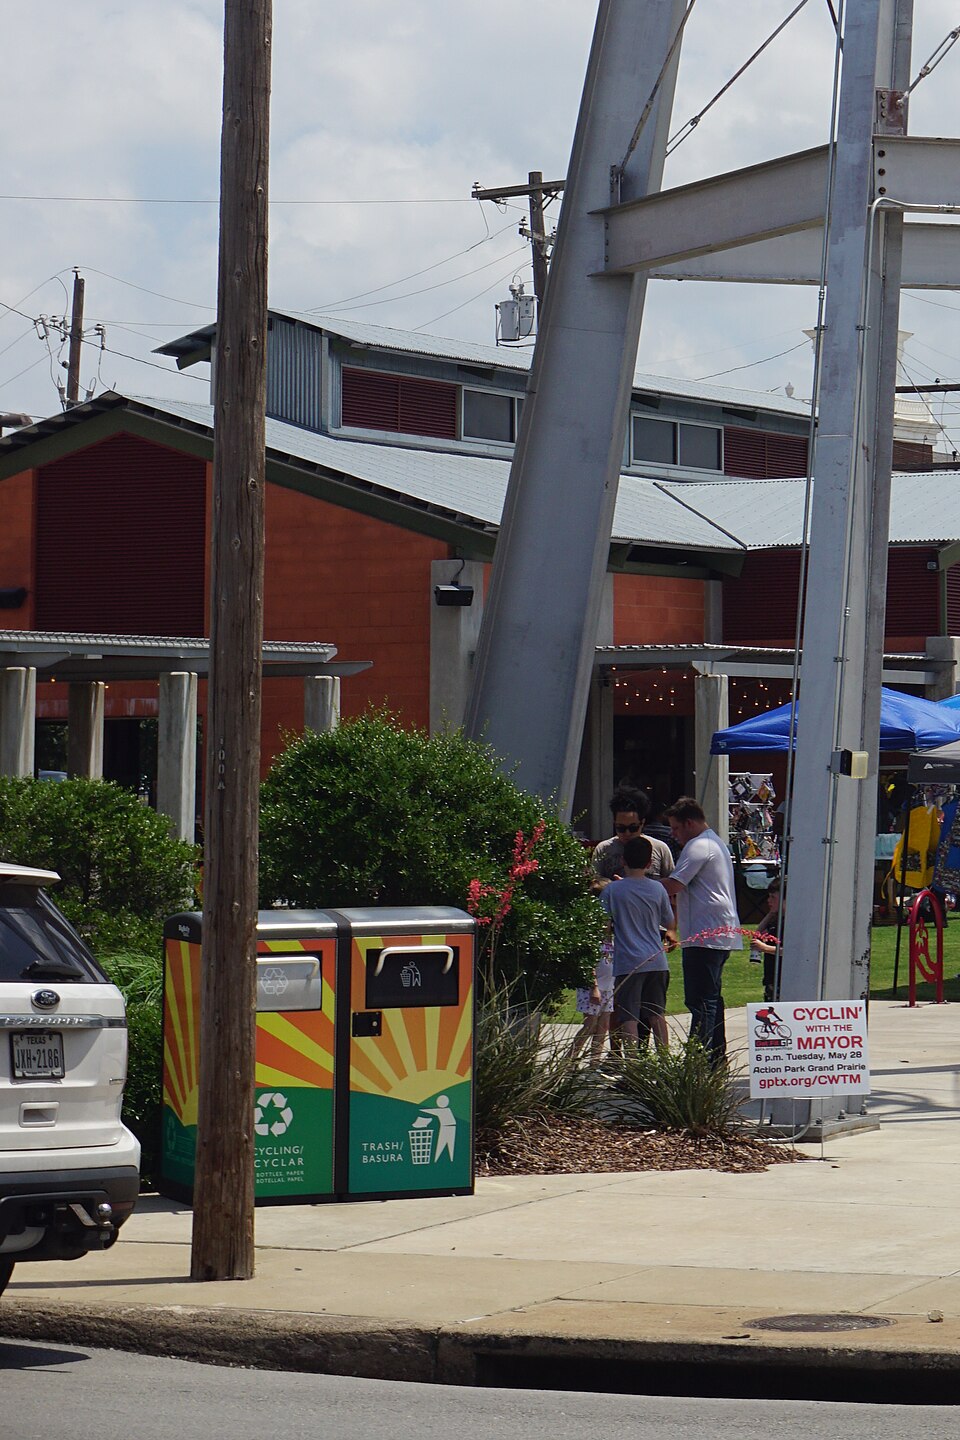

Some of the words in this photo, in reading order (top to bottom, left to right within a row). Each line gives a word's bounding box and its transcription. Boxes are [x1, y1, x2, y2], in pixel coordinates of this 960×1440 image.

[793, 1006, 863, 1021] CYCLIN'
[805, 1024, 831, 1032] WITH
[833, 1024, 853, 1032] THE
[27, 1036, 46, 1045] TEXAS
[797, 1035, 863, 1050] MAYOR
[755, 1054, 762, 1062] 6
[765, 1054, 784, 1063] p.m.
[786, 1052, 826, 1061] Tuesday,
[828, 1051, 847, 1060] May
[850, 1051, 862, 1059] 28
[753, 1065, 782, 1074] Action
[784, 1064, 805, 1073] Park
[807, 1064, 834, 1072] Grand
[837, 1063, 866, 1071] Prairie
[759, 1074, 861, 1089] gptx.org/CWTM
[254, 1145, 304, 1156] CYCLING/
[362, 1141, 404, 1152] TRASH/
[254, 1157, 304, 1168] CYCLAR
[362, 1153, 404, 1164] BASURA
